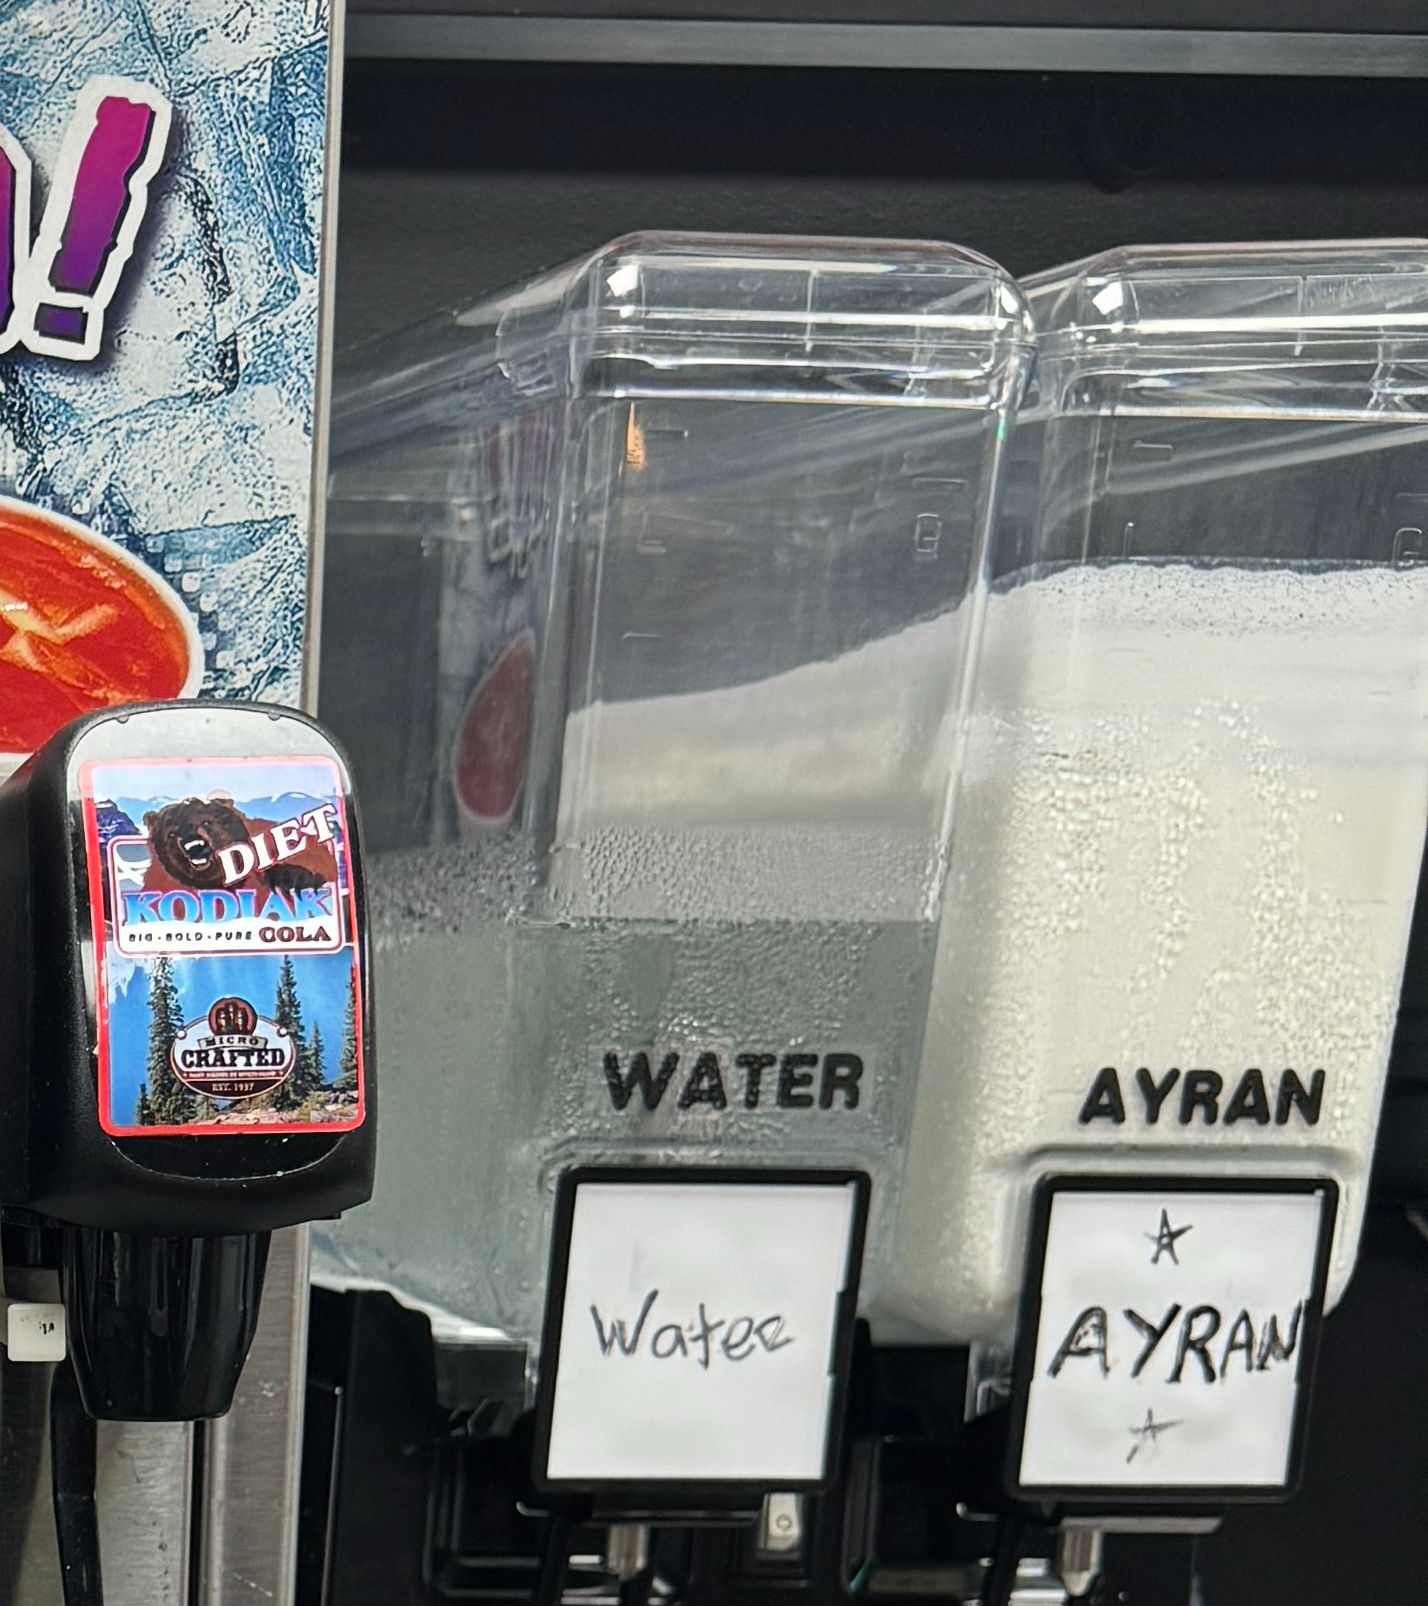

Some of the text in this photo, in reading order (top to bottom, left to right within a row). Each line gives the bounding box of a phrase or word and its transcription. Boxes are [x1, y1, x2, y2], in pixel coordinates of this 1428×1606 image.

[218, 803, 338, 886] DIET
[121, 888, 332, 926] KODIAK
[165, 932, 203, 941] BOLD
[214, 931, 252, 940] PURE
[258, 926, 332, 943] COLA
[180, 1048, 285, 1069] CRAFTED
[205, 1036, 260, 1047] MICRO
[602, 1051, 864, 1111] WATER
[1078, 1067, 1326, 1125] AYRAN
[590, 1287, 794, 1372] Water
[1046, 1299, 1305, 1385] AYRAN
